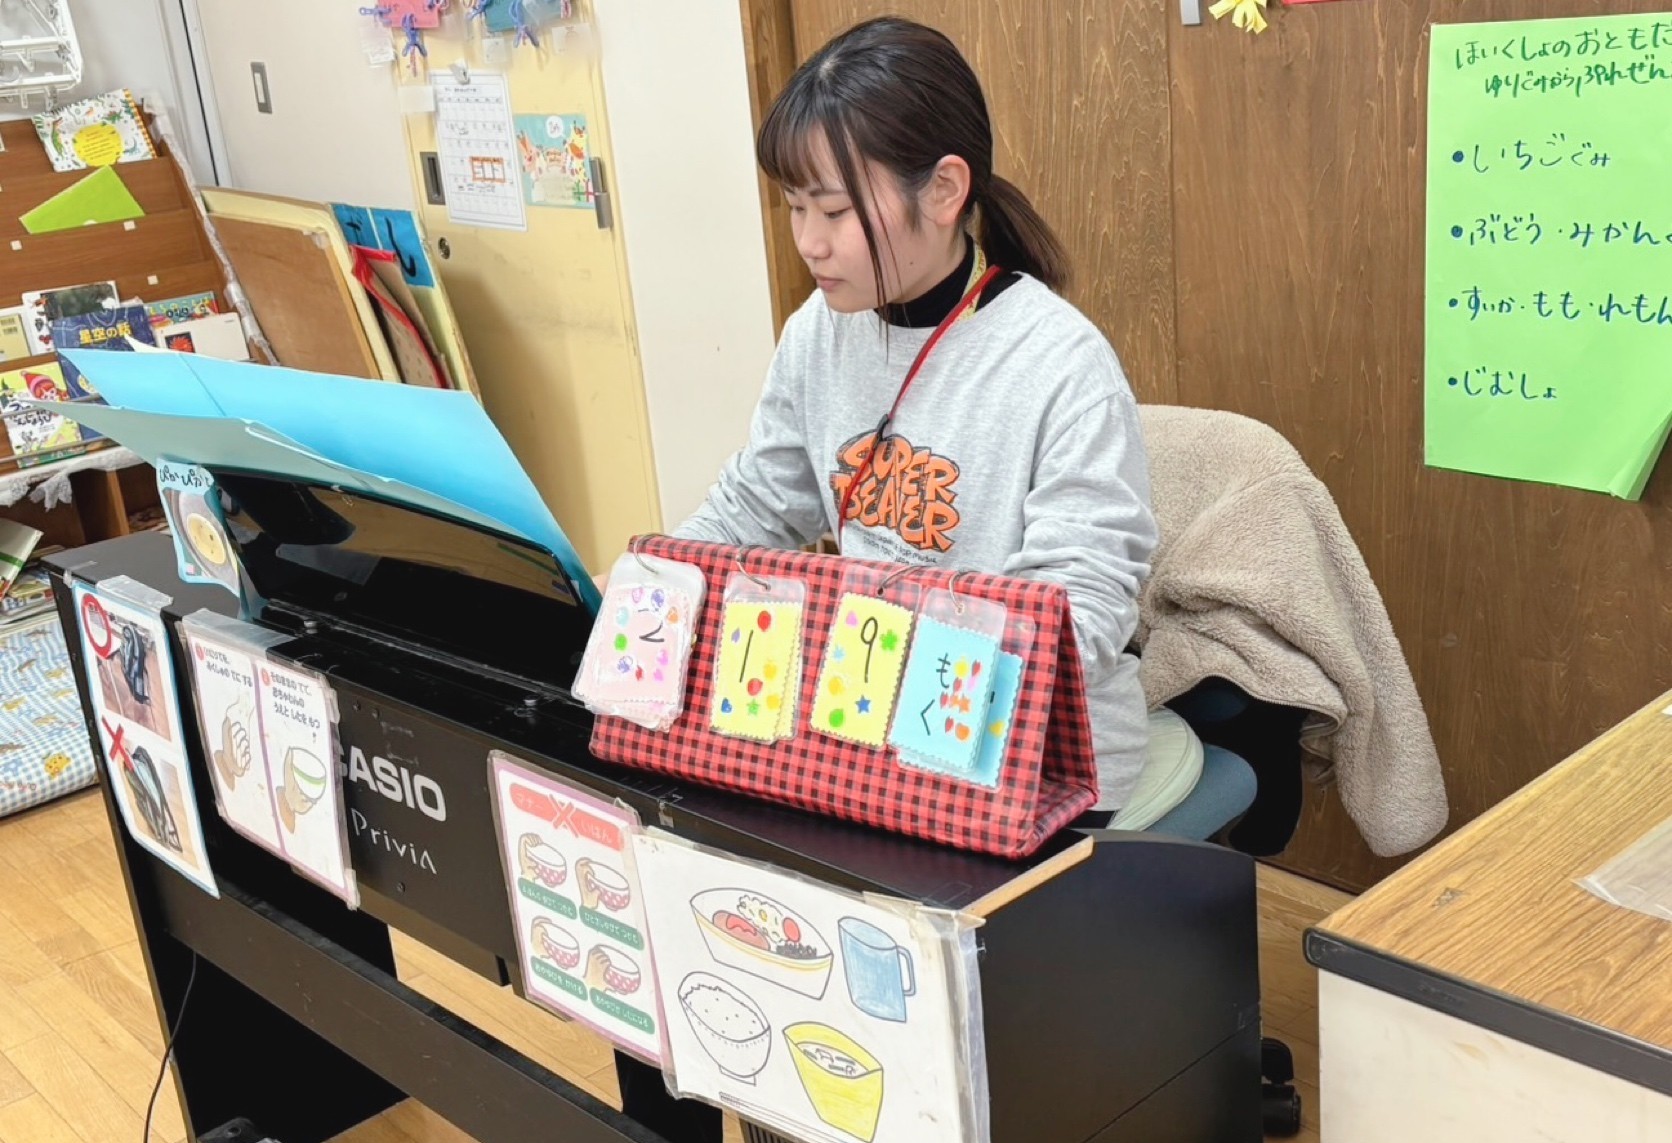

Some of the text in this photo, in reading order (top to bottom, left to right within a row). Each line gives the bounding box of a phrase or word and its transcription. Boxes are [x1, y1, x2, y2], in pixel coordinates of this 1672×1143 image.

[1473, 133, 1611, 173] いちごぐみ
[1470, 213, 1672, 247] ぶどう・みかん
[1464, 366, 1557, 400] じむしょ
[860, 616, 879, 684] 9
